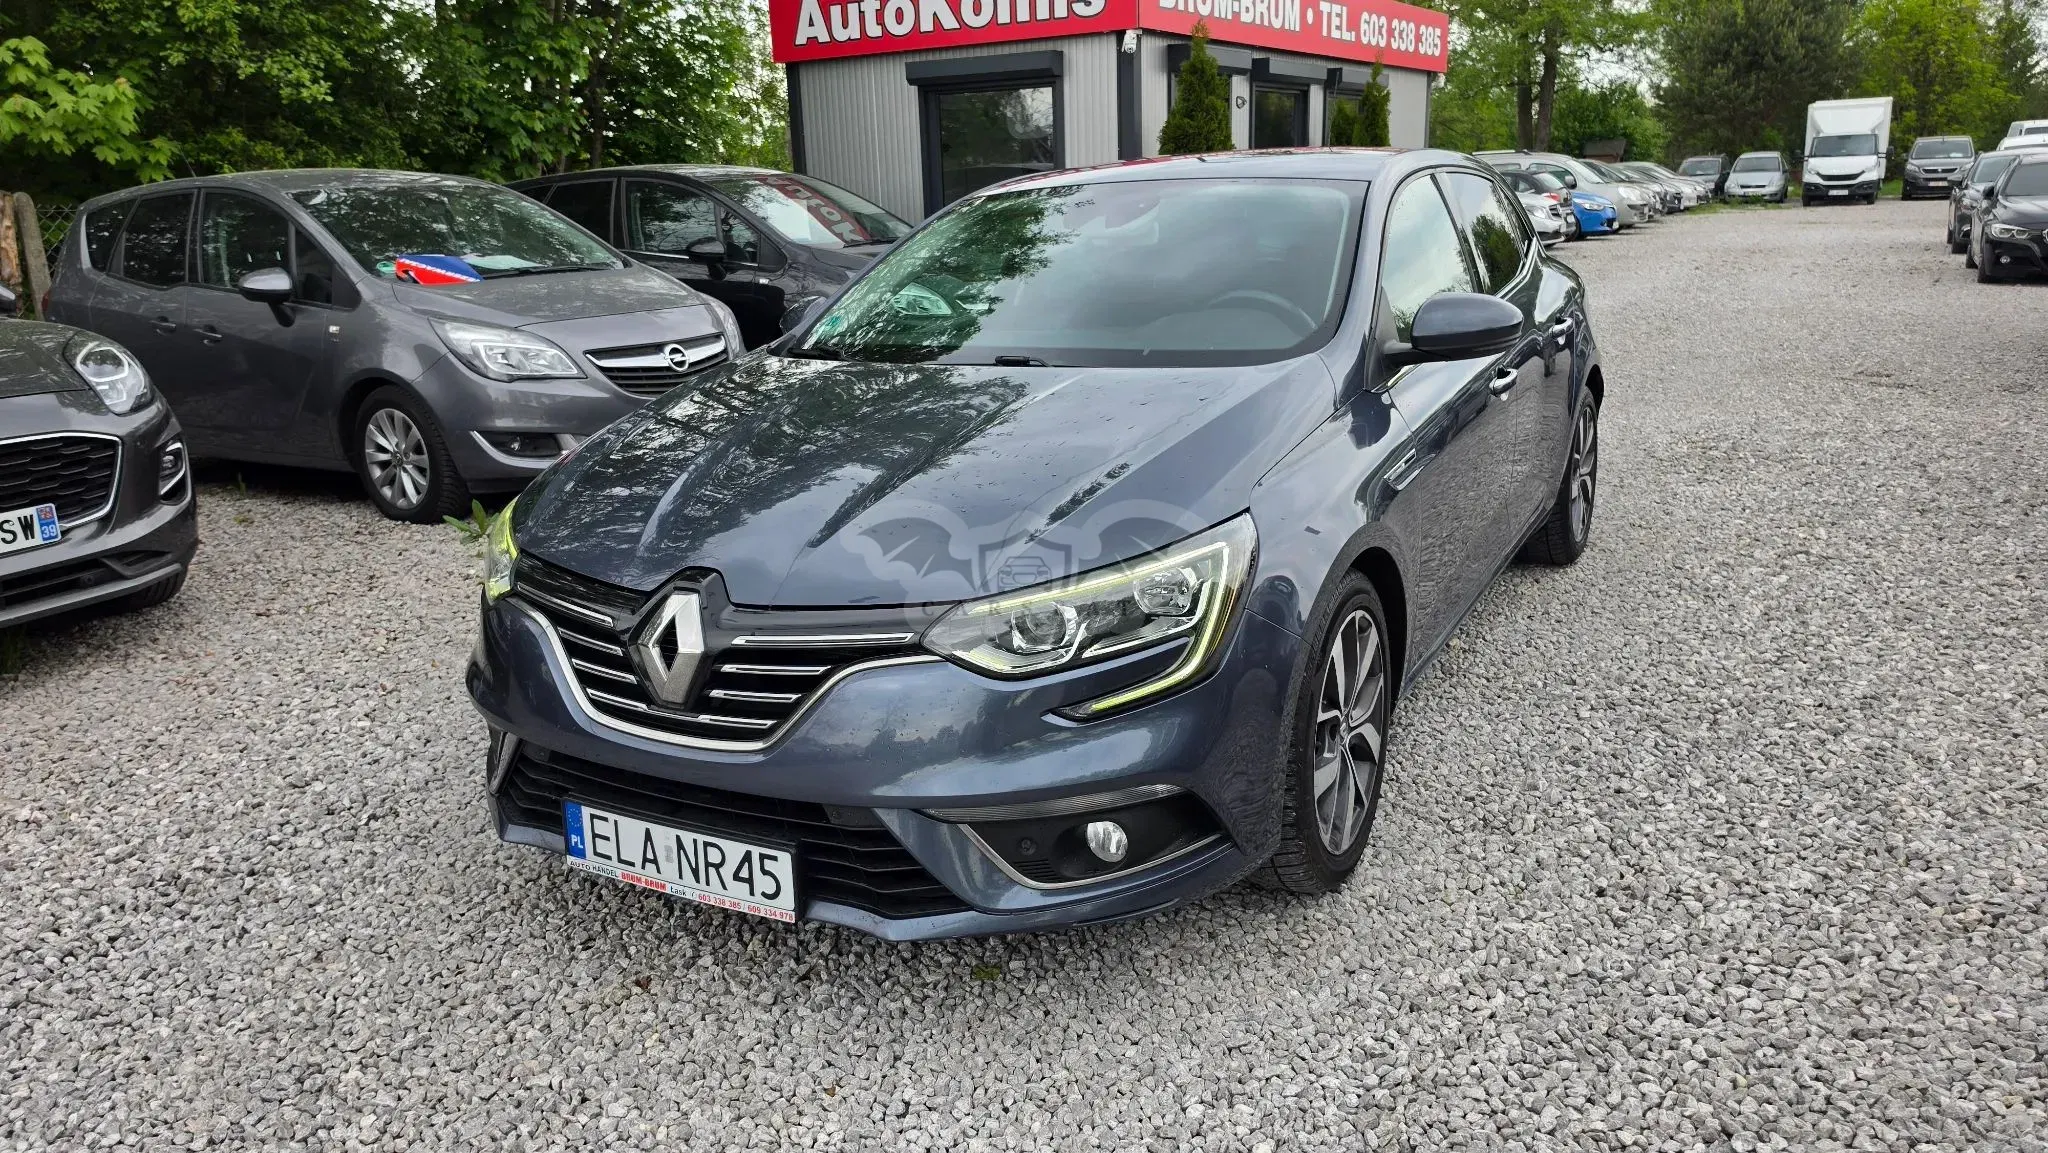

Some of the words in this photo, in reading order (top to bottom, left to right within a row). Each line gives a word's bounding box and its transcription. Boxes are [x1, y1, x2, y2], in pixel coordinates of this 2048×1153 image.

[1159, 0, 1300, 32] M-BRUM
[1319, 1, 1356, 42] TEL.
[1360, 11, 1387, 47] 603
[1391, 18, 1415, 53] 338
[1418, 24, 1442, 57] 385
[41, 524, 57, 538] 39
[571, 834, 583, 849] PL
[590, 813, 662, 875] ELA
[676, 834, 782, 901] NR45
[570, 860, 591, 870] AUTO
[593, 864, 619, 878] HANDEL
[621, 871, 667, 892] BRUM-BRUM
[698, 893, 711, 903] 603
[713, 896, 726, 907] 338
[728, 900, 742, 910] 385
[747, 904, 761, 914] 609
[763, 908, 778, 918] 334
[779, 911, 794, 922] 978
